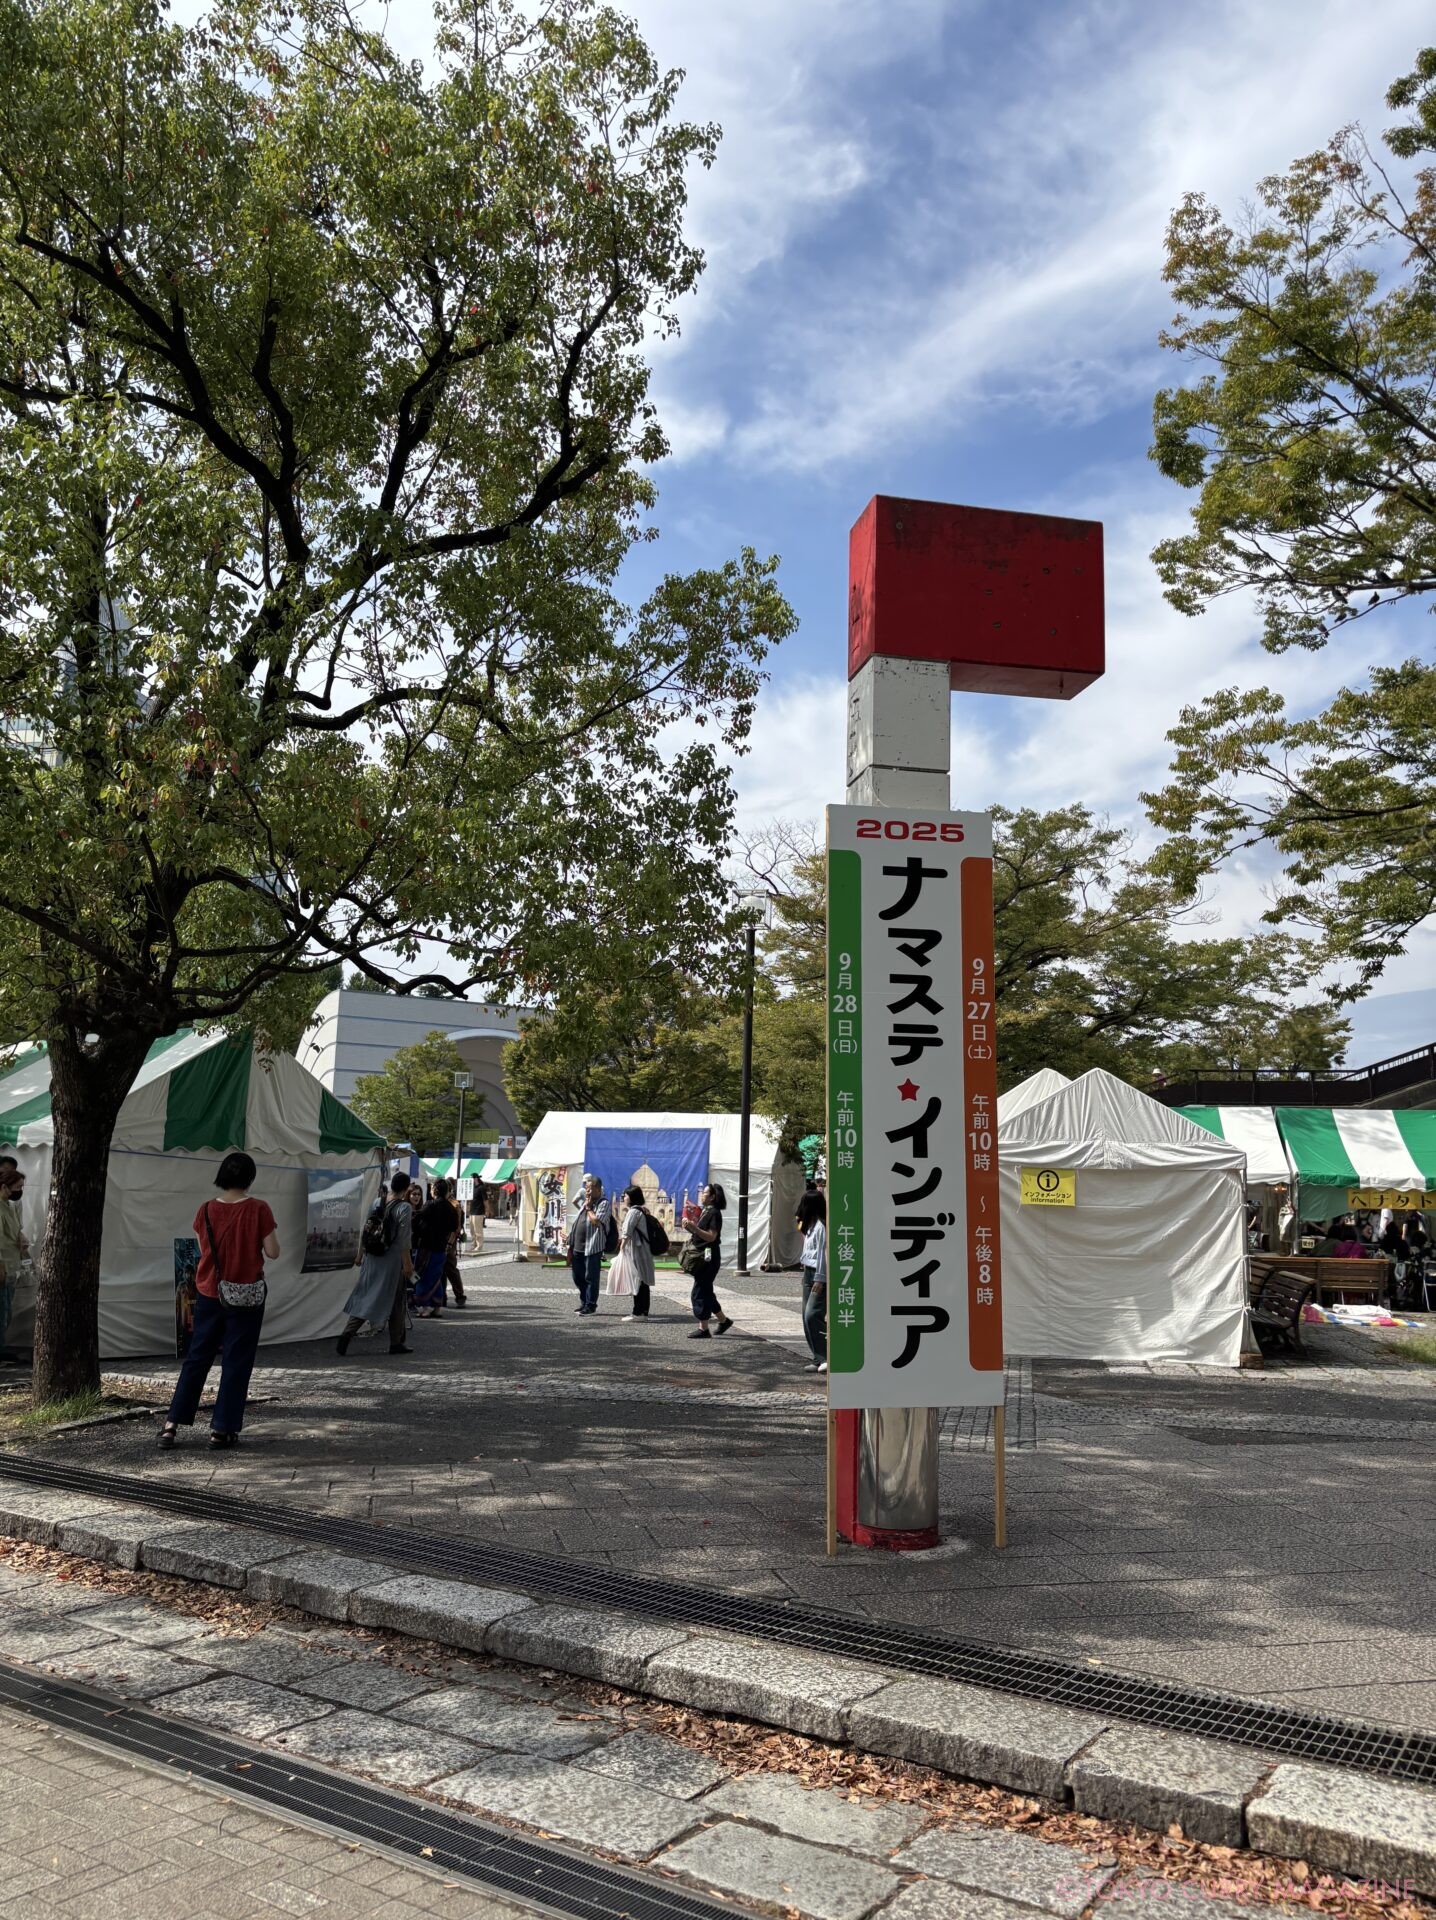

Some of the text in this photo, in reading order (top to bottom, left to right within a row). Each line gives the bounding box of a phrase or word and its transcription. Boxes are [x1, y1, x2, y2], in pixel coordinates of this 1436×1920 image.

[856, 819, 965, 843] 2025
[833, 1090, 858, 1169] 午前10時
[968, 1093, 993, 1171] 午前10時
[1024, 1191, 1072, 1199] インフォメーション
[974, 1225, 994, 1306] 午後8時
